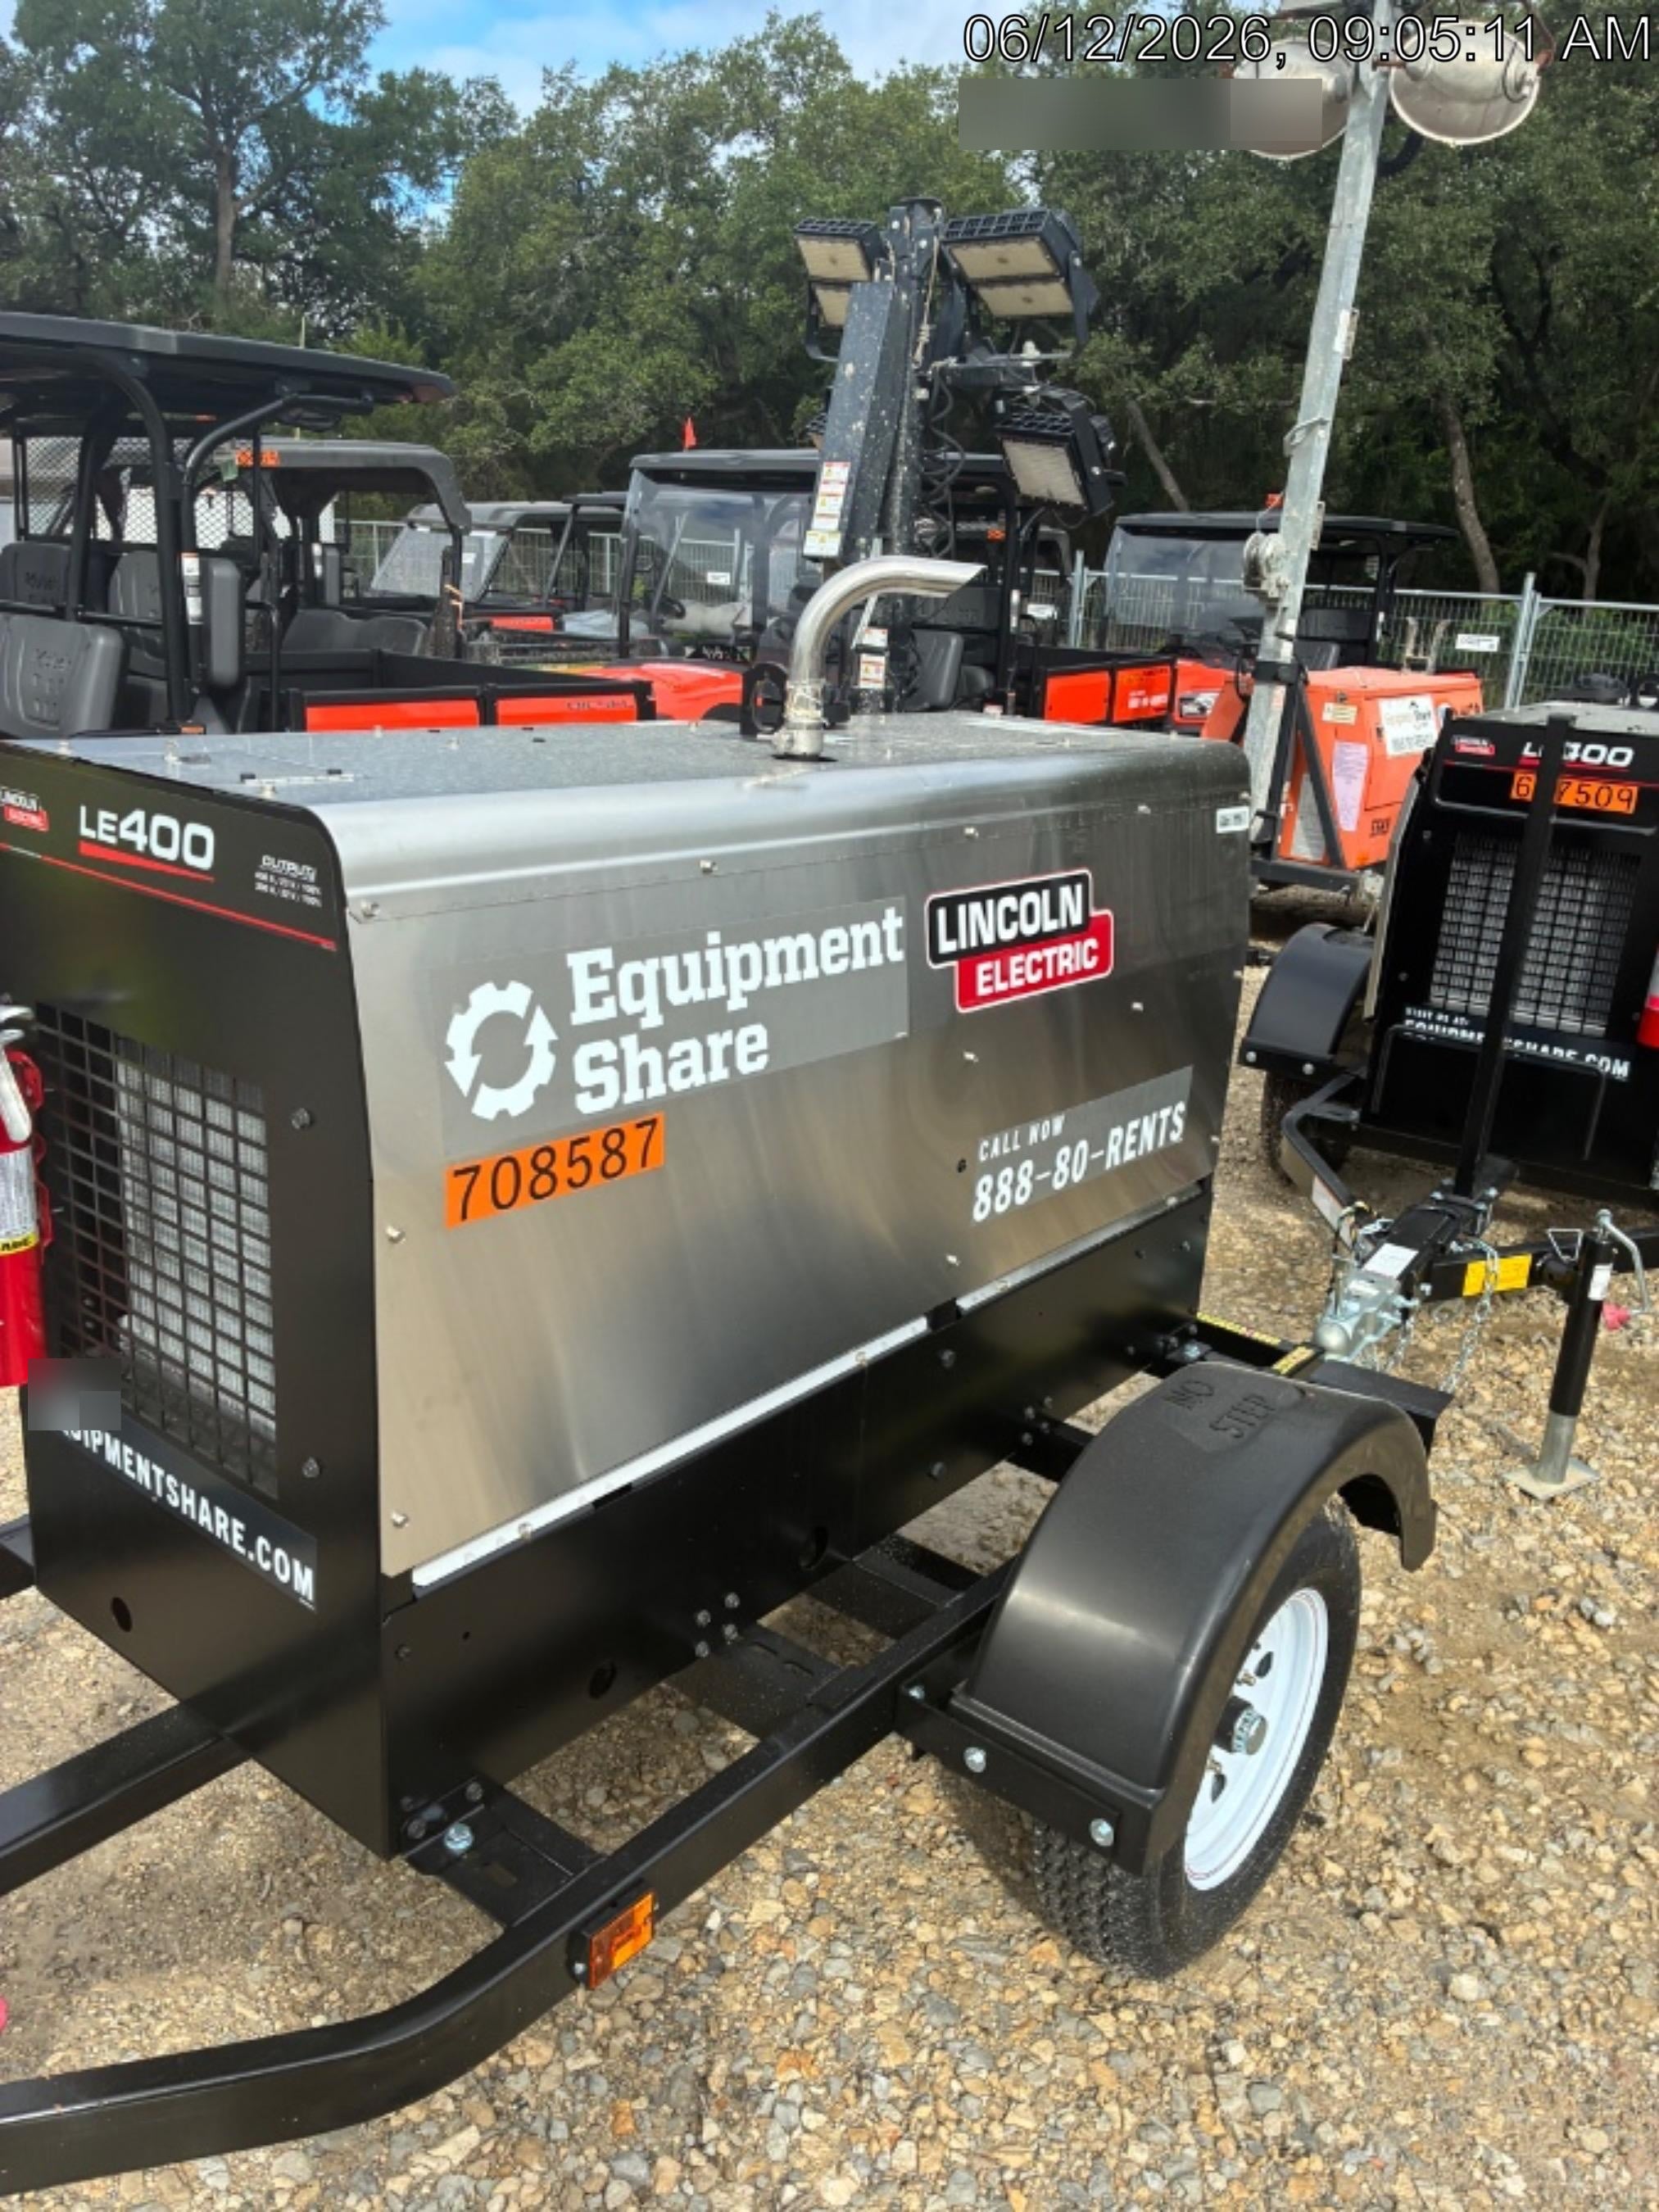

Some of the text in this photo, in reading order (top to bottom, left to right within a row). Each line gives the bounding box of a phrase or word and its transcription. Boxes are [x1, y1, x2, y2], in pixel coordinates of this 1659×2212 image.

[1516, 776, 1634, 810] 67509
[79, 805, 215, 871] LE400
[936, 882, 1083, 954] LINCOLN
[567, 906, 904, 1029] Equipment
[976, 937, 1099, 996] ELECTRIC
[573, 1022, 769, 1115] Share
[453, 1117, 659, 1222] 708587
[972, 1099, 1187, 1223] 888-80-RENTS
[978, 1113, 1065, 1163] CALL NOW
[1208, 1394, 1276, 1439] STEP
